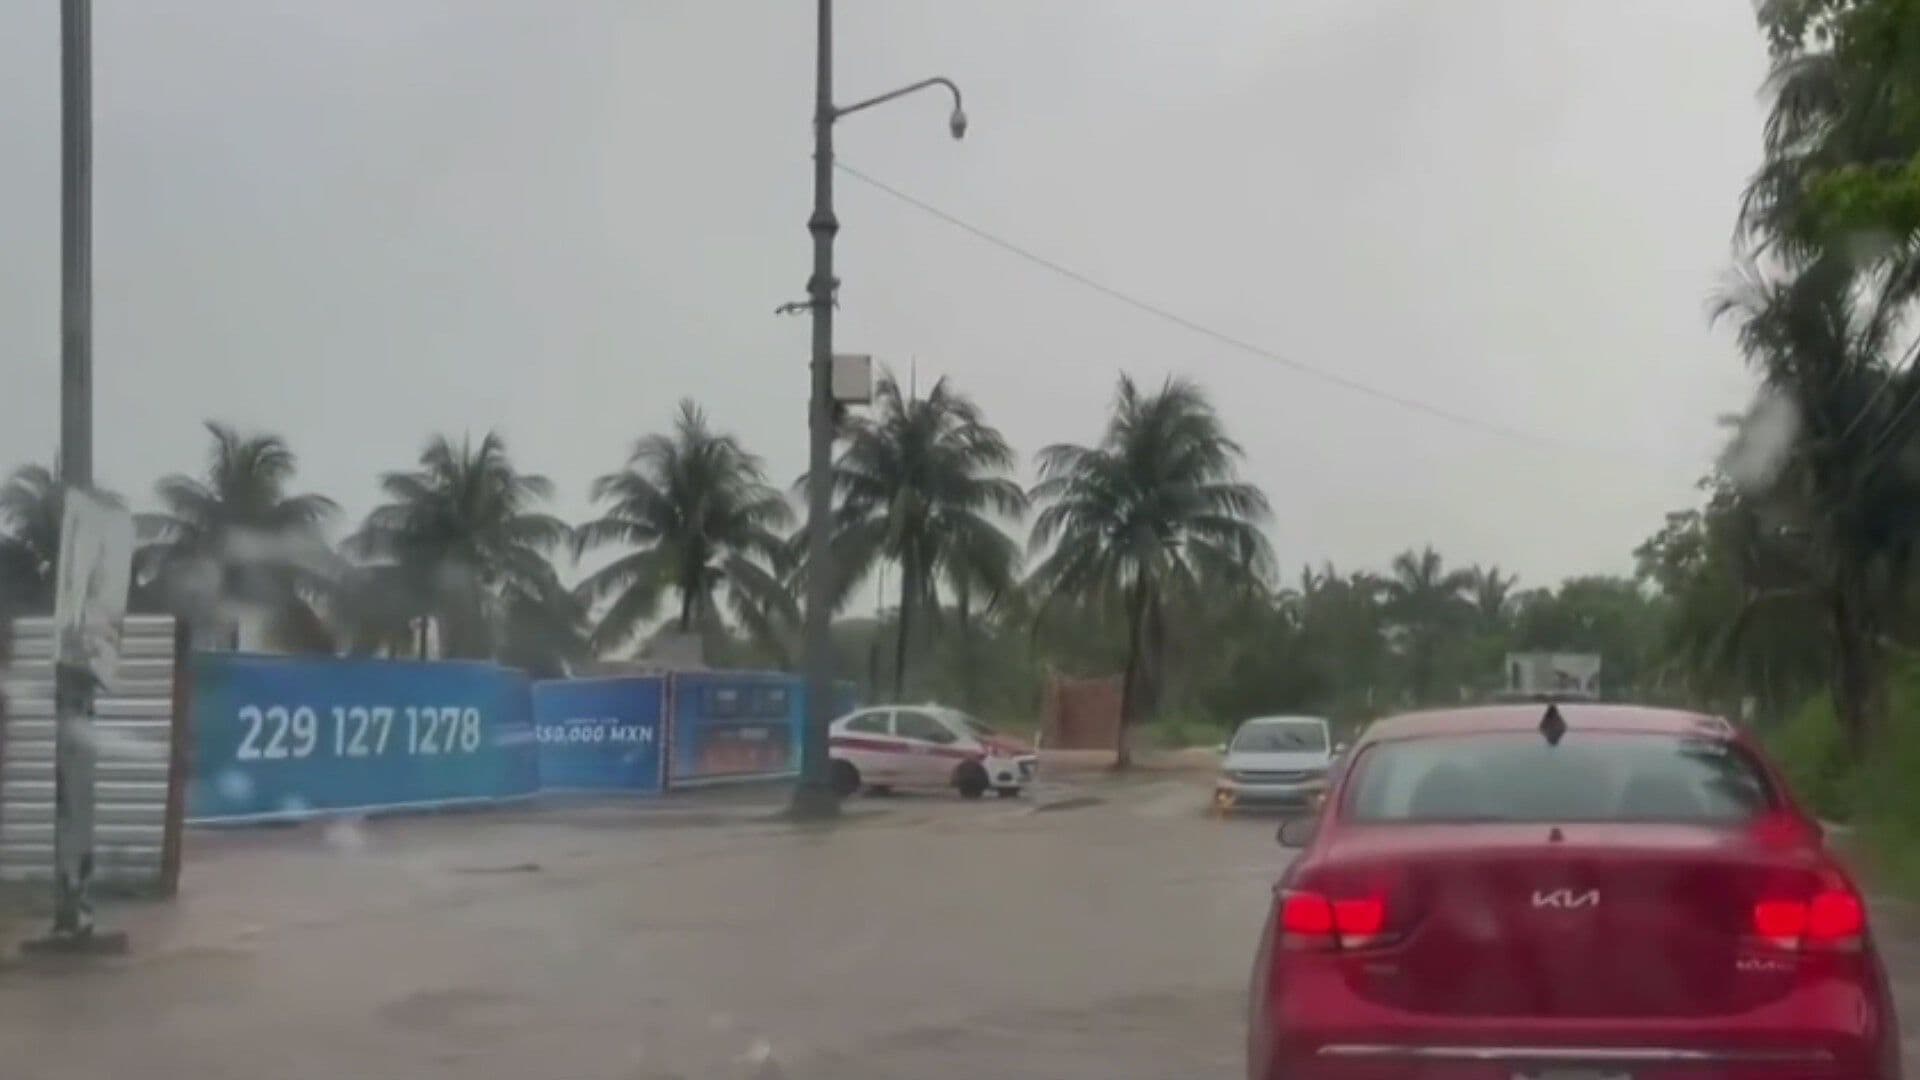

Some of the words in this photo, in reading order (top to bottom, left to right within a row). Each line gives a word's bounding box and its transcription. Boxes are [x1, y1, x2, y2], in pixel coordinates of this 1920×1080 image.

[237, 705, 316, 760] 229
[332, 706, 393, 757] 127
[406, 706, 481, 754] 1278
[611, 725, 653, 744] MXN
[1532, 889, 1600, 908] KIA
